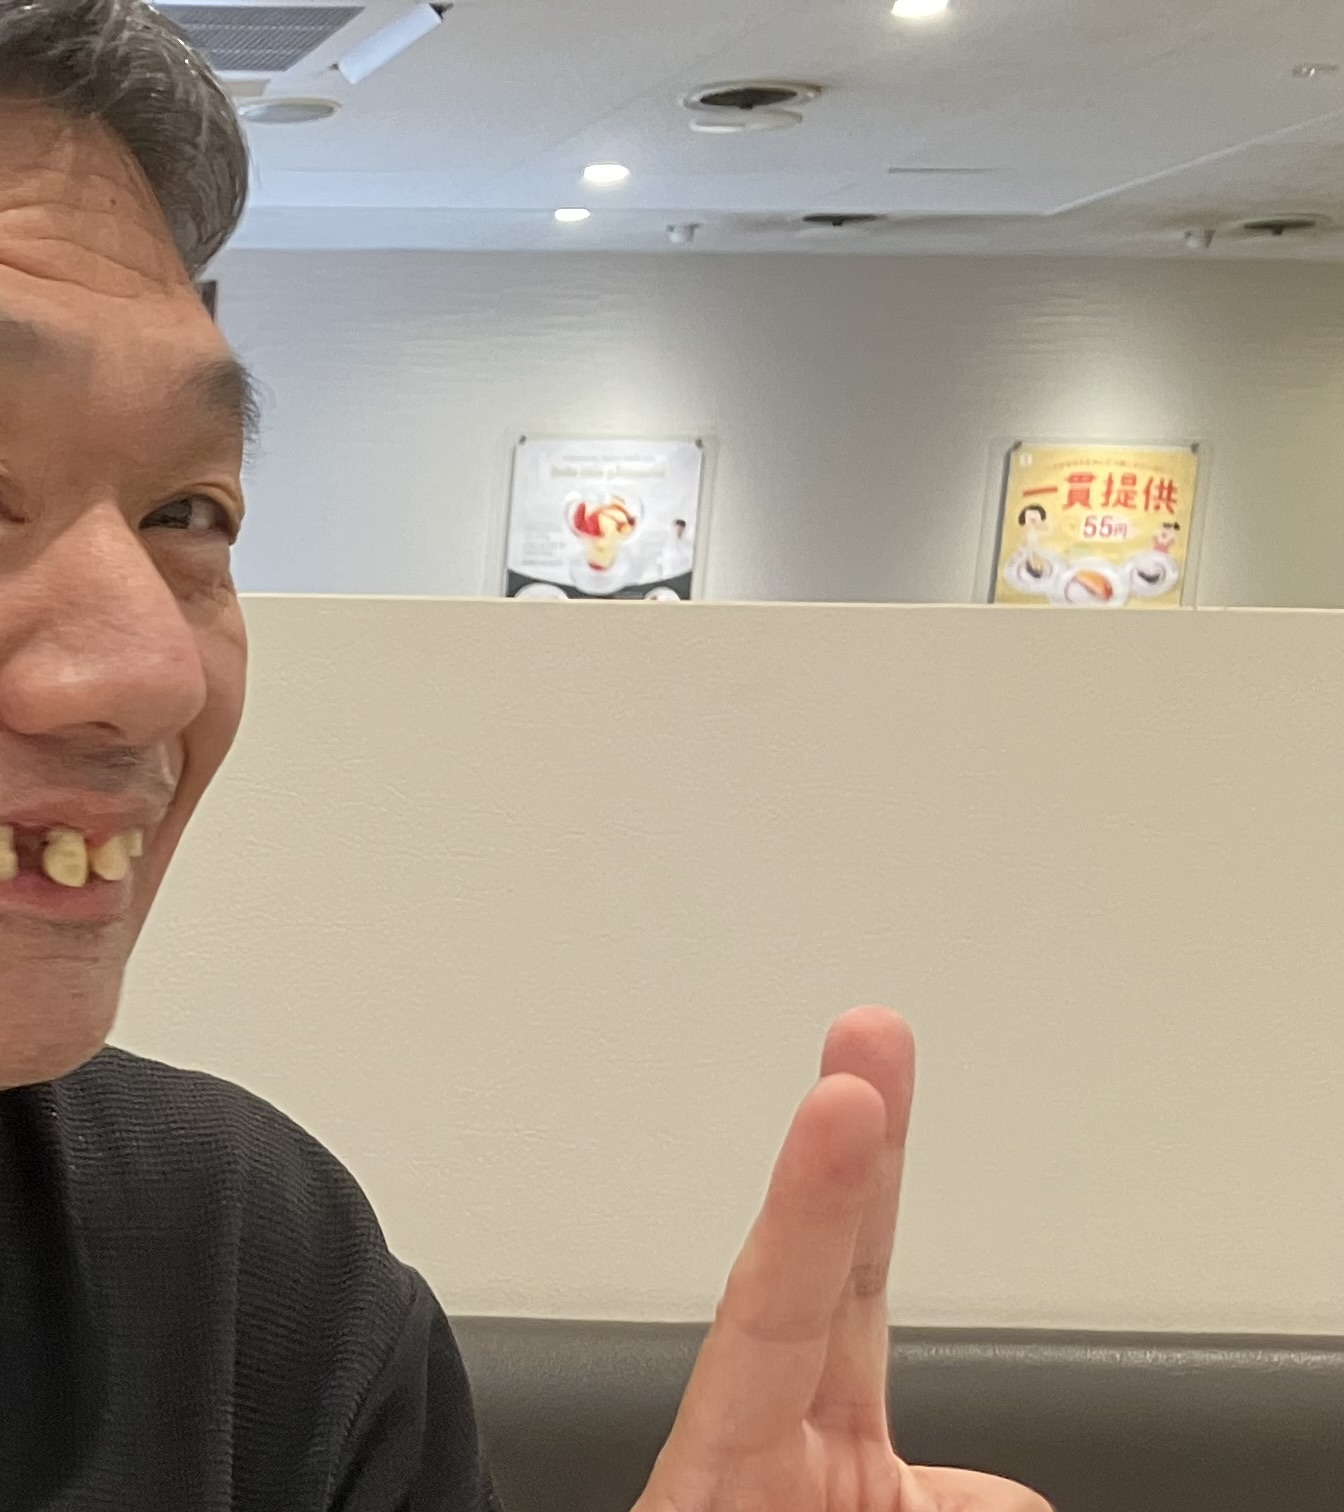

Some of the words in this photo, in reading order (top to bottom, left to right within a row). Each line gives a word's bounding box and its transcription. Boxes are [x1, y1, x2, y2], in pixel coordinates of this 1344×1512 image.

[1022, 471, 1179, 515] 一貫提供
[1083, 515, 1128, 539] 55円
